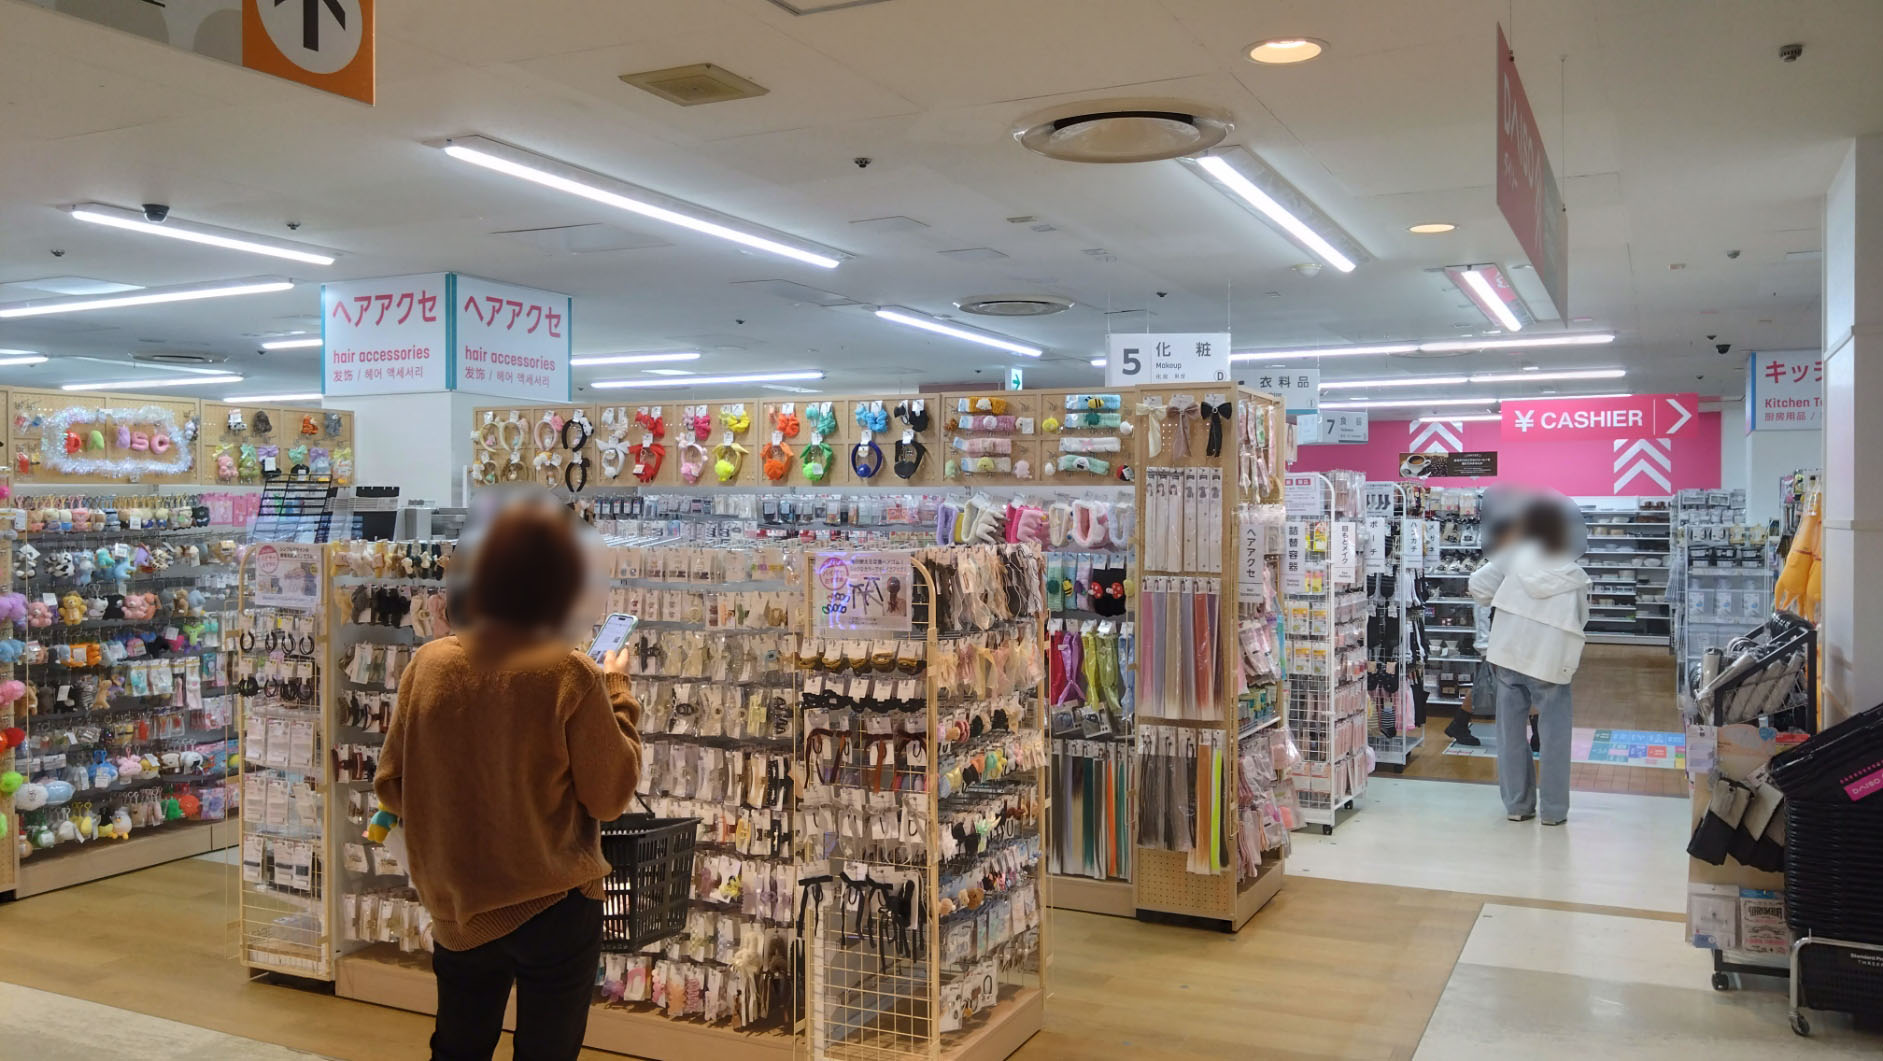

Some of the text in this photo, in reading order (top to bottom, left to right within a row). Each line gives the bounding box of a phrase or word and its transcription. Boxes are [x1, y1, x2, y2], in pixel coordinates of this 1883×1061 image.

[333, 290, 437, 327] ヘアアクセ
[464, 295, 561, 338] ヘアアクセ
[333, 345, 430, 364] hair accessories
[465, 345, 555, 371] hair accessories
[1156, 342, 1211, 357] 化粧
[1122, 348, 1142, 375] 5
[1155, 362, 1182, 370] Makeup
[333, 369, 353, 382] 发饰
[1217, 372, 1224, 380] D
[1260, 376, 1309, 388] 衣料品
[1765, 397, 1823, 408] Kitchen T
[1326, 419, 1335, 434] 7
[1515, 409, 1643, 432] ¥ CASHIER
[1247, 528, 1256, 578] ヘアアクセ
